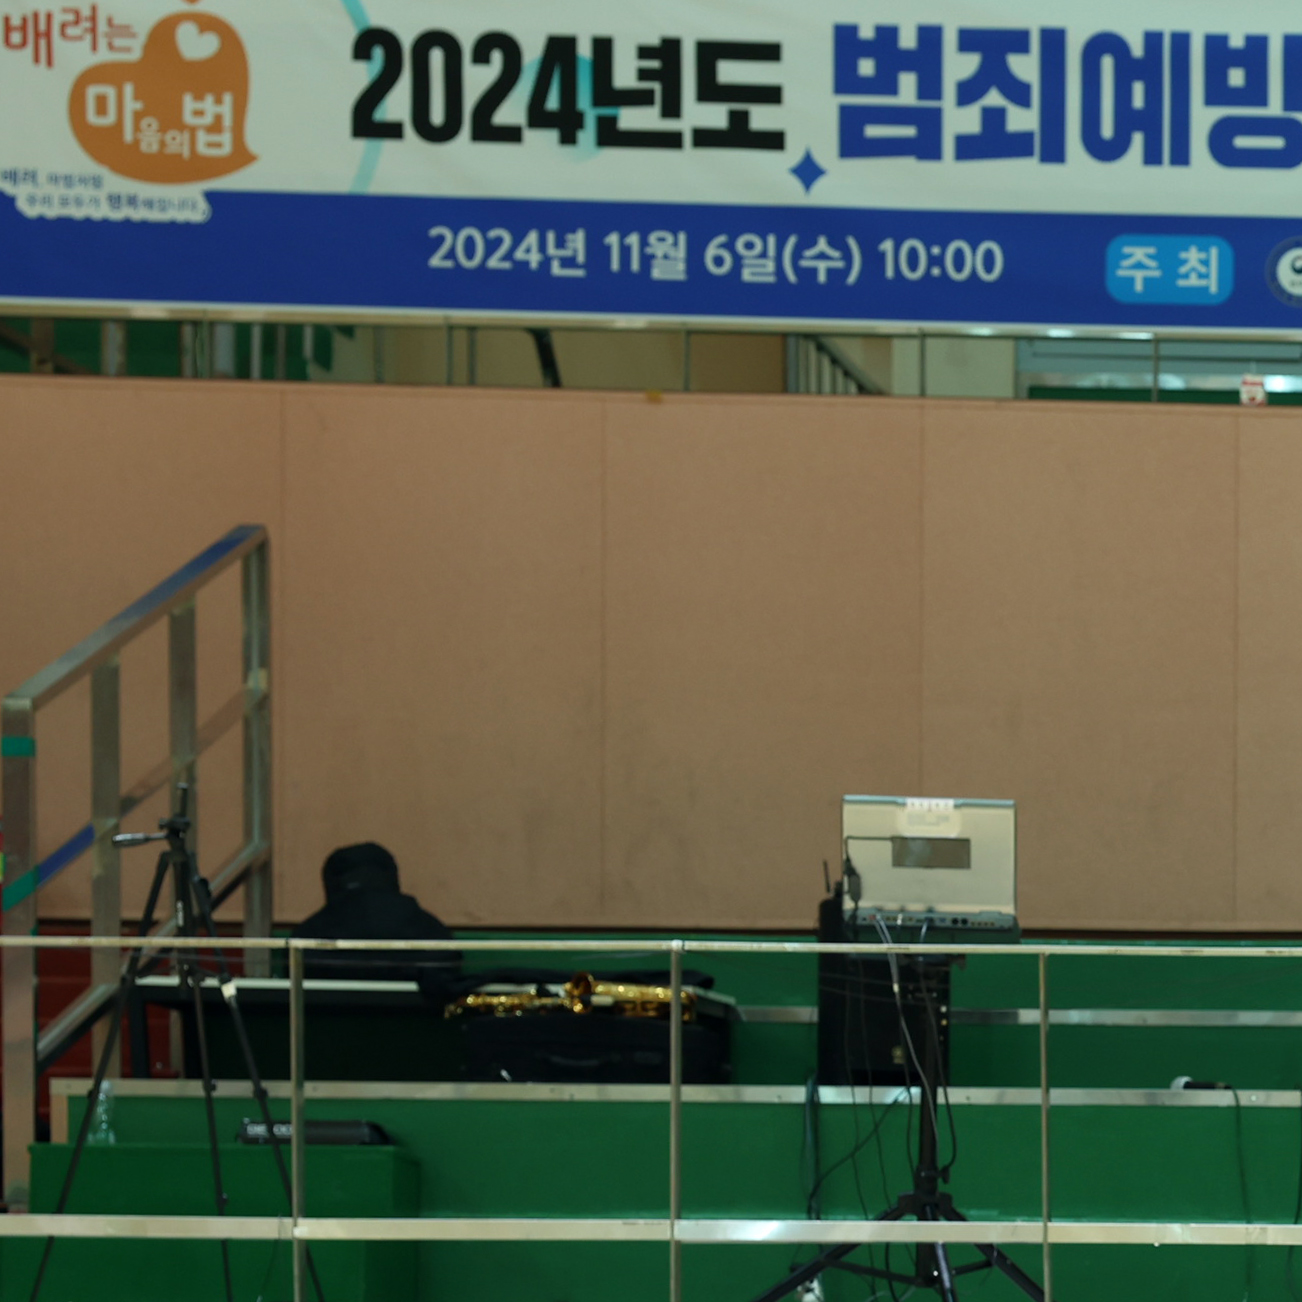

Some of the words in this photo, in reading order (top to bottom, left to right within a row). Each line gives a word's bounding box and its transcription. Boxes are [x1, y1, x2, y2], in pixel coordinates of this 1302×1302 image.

[3, 3, 138, 69] 배려는
[351, 26, 786, 151] 2024년도
[428, 226, 586, 278] 2024년
[604, 230, 688, 282] 11월
[704, 234, 861, 286] 6일(수)
[878, 239, 1003, 283] 10:00
